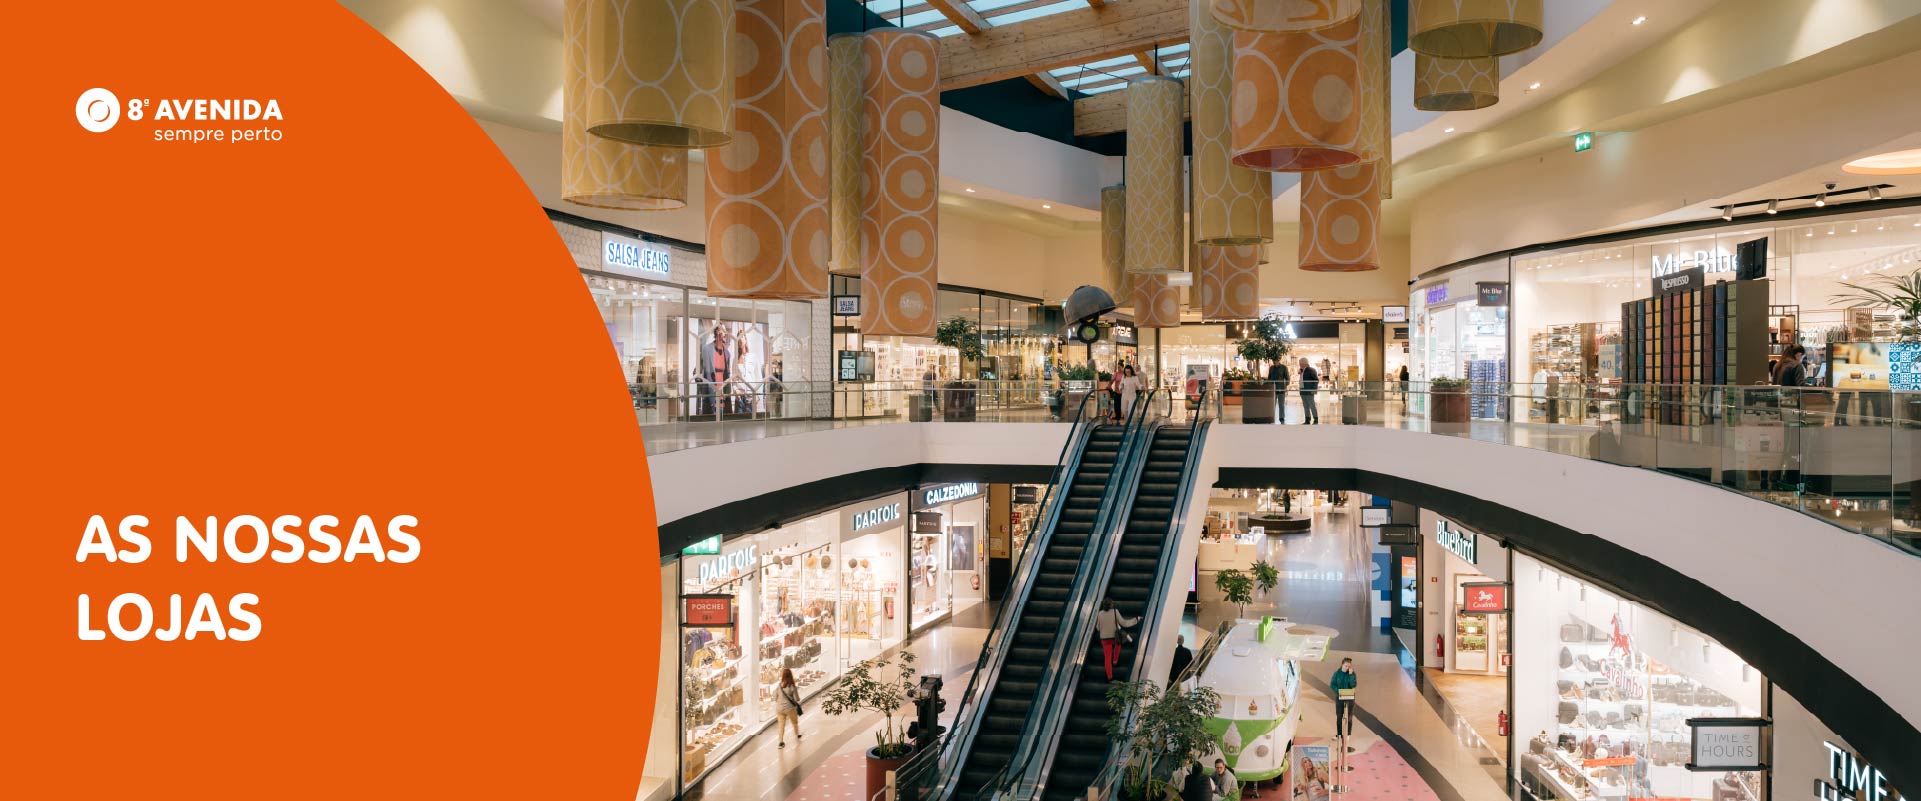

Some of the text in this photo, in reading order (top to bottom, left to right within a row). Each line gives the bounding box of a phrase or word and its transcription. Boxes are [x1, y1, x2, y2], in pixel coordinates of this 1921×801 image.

[608, 242, 669, 273] SALSA JEANS
[1492, 287, 1503, 295] Blue
[926, 481, 978, 506] CALZEDONIA
[1437, 519, 1475, 565] BlueBird
[1472, 601, 1498, 609] Cavalinho
[1600, 657, 1644, 699] Cavalinho
[1703, 733, 1738, 743] TIME
[1701, 745, 1754, 758] HOURS
